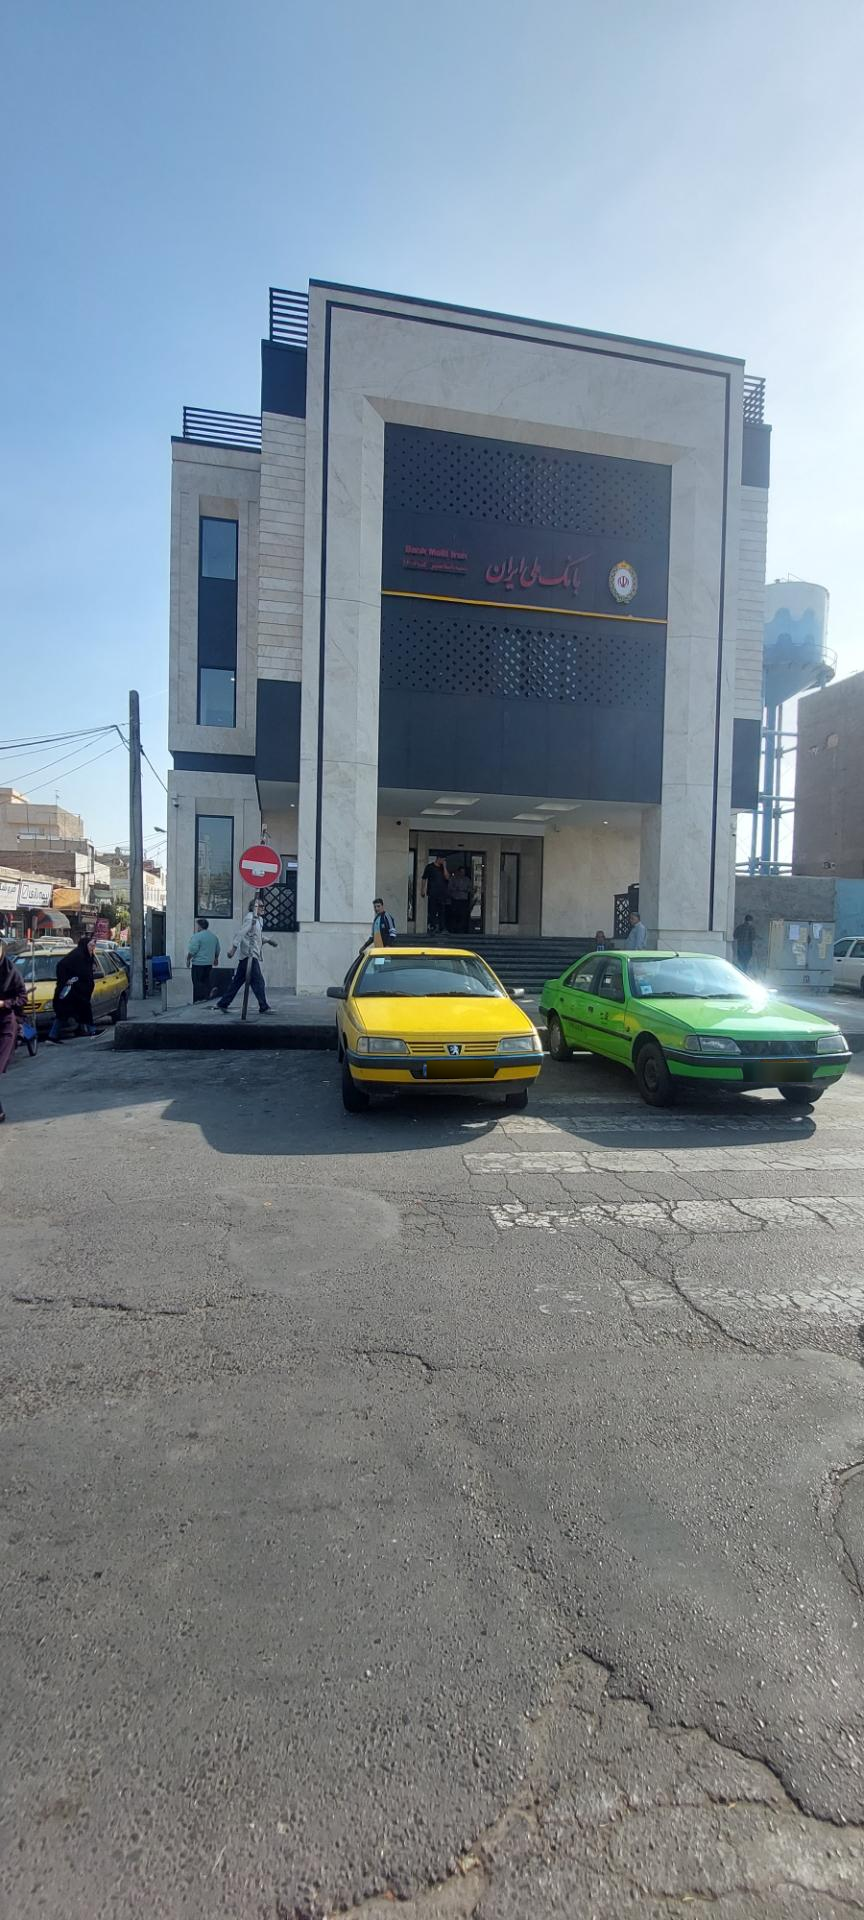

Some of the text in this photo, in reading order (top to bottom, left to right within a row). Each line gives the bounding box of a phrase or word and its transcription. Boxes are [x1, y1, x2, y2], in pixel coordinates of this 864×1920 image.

[405, 544, 469, 560] Bank Melli Iran
[486, 556, 525, 590] ایران
[520, 555, 541, 588] ملی
[538, 551, 593, 596] بانک
